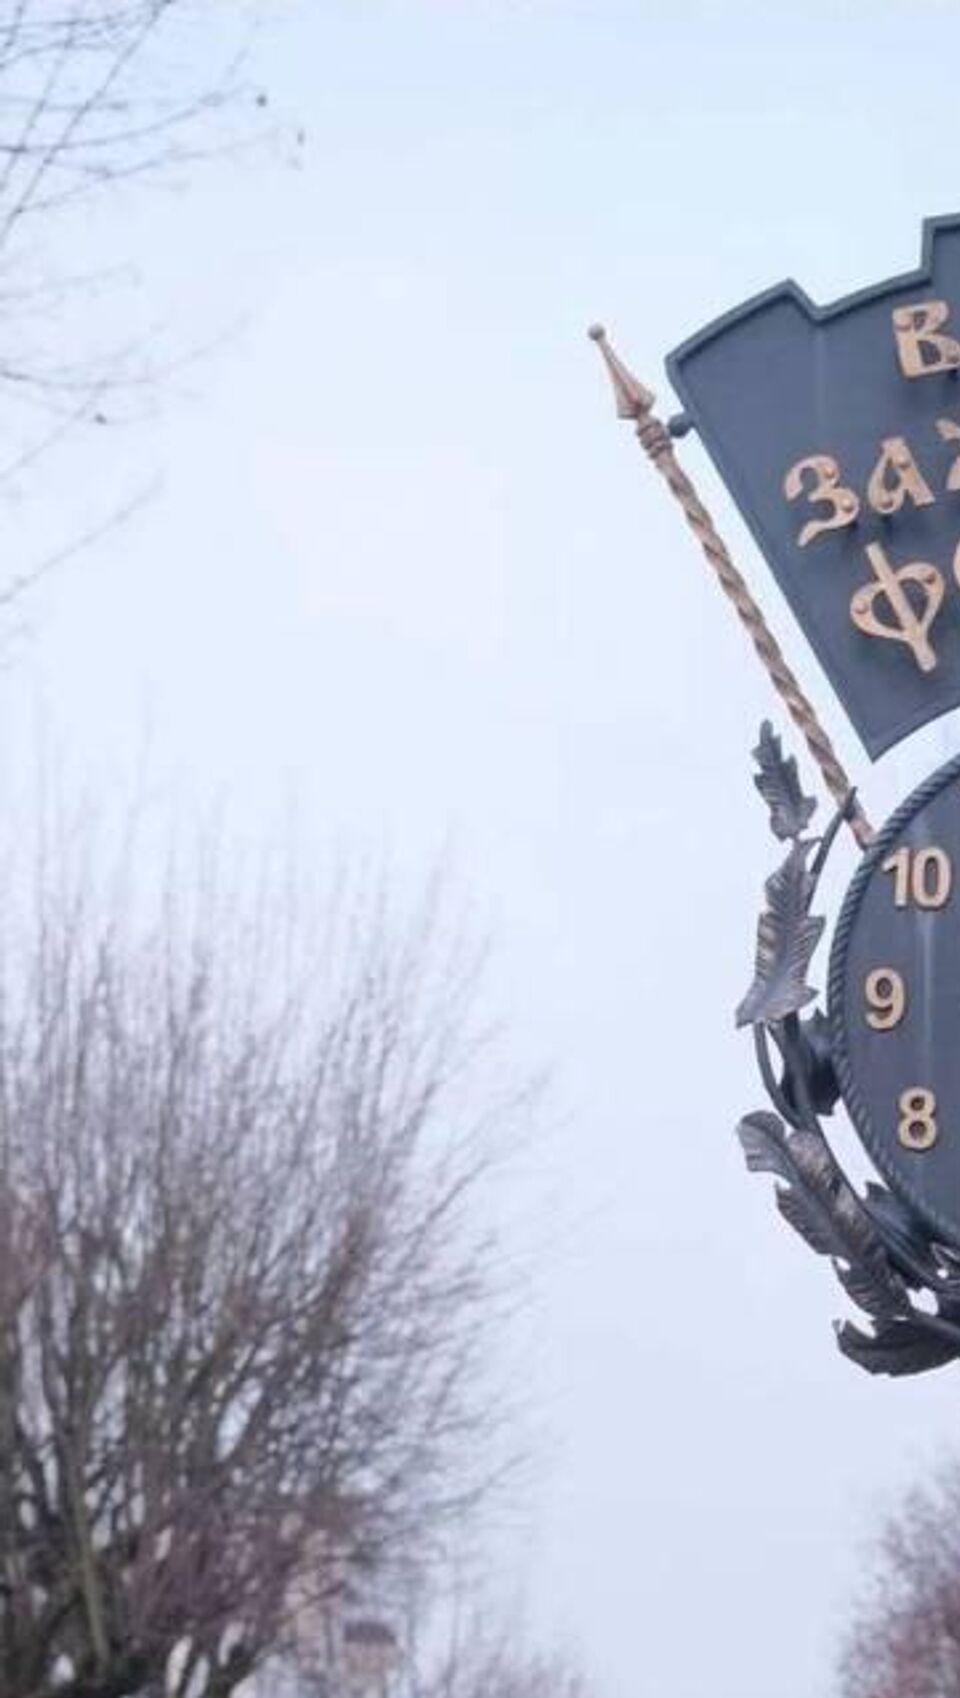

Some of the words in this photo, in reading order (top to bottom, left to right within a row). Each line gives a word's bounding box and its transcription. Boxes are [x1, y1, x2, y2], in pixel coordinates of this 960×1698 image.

[882, 847, 952, 908] 10
[865, 968, 906, 1031] 9
[899, 1088, 937, 1150] 8
